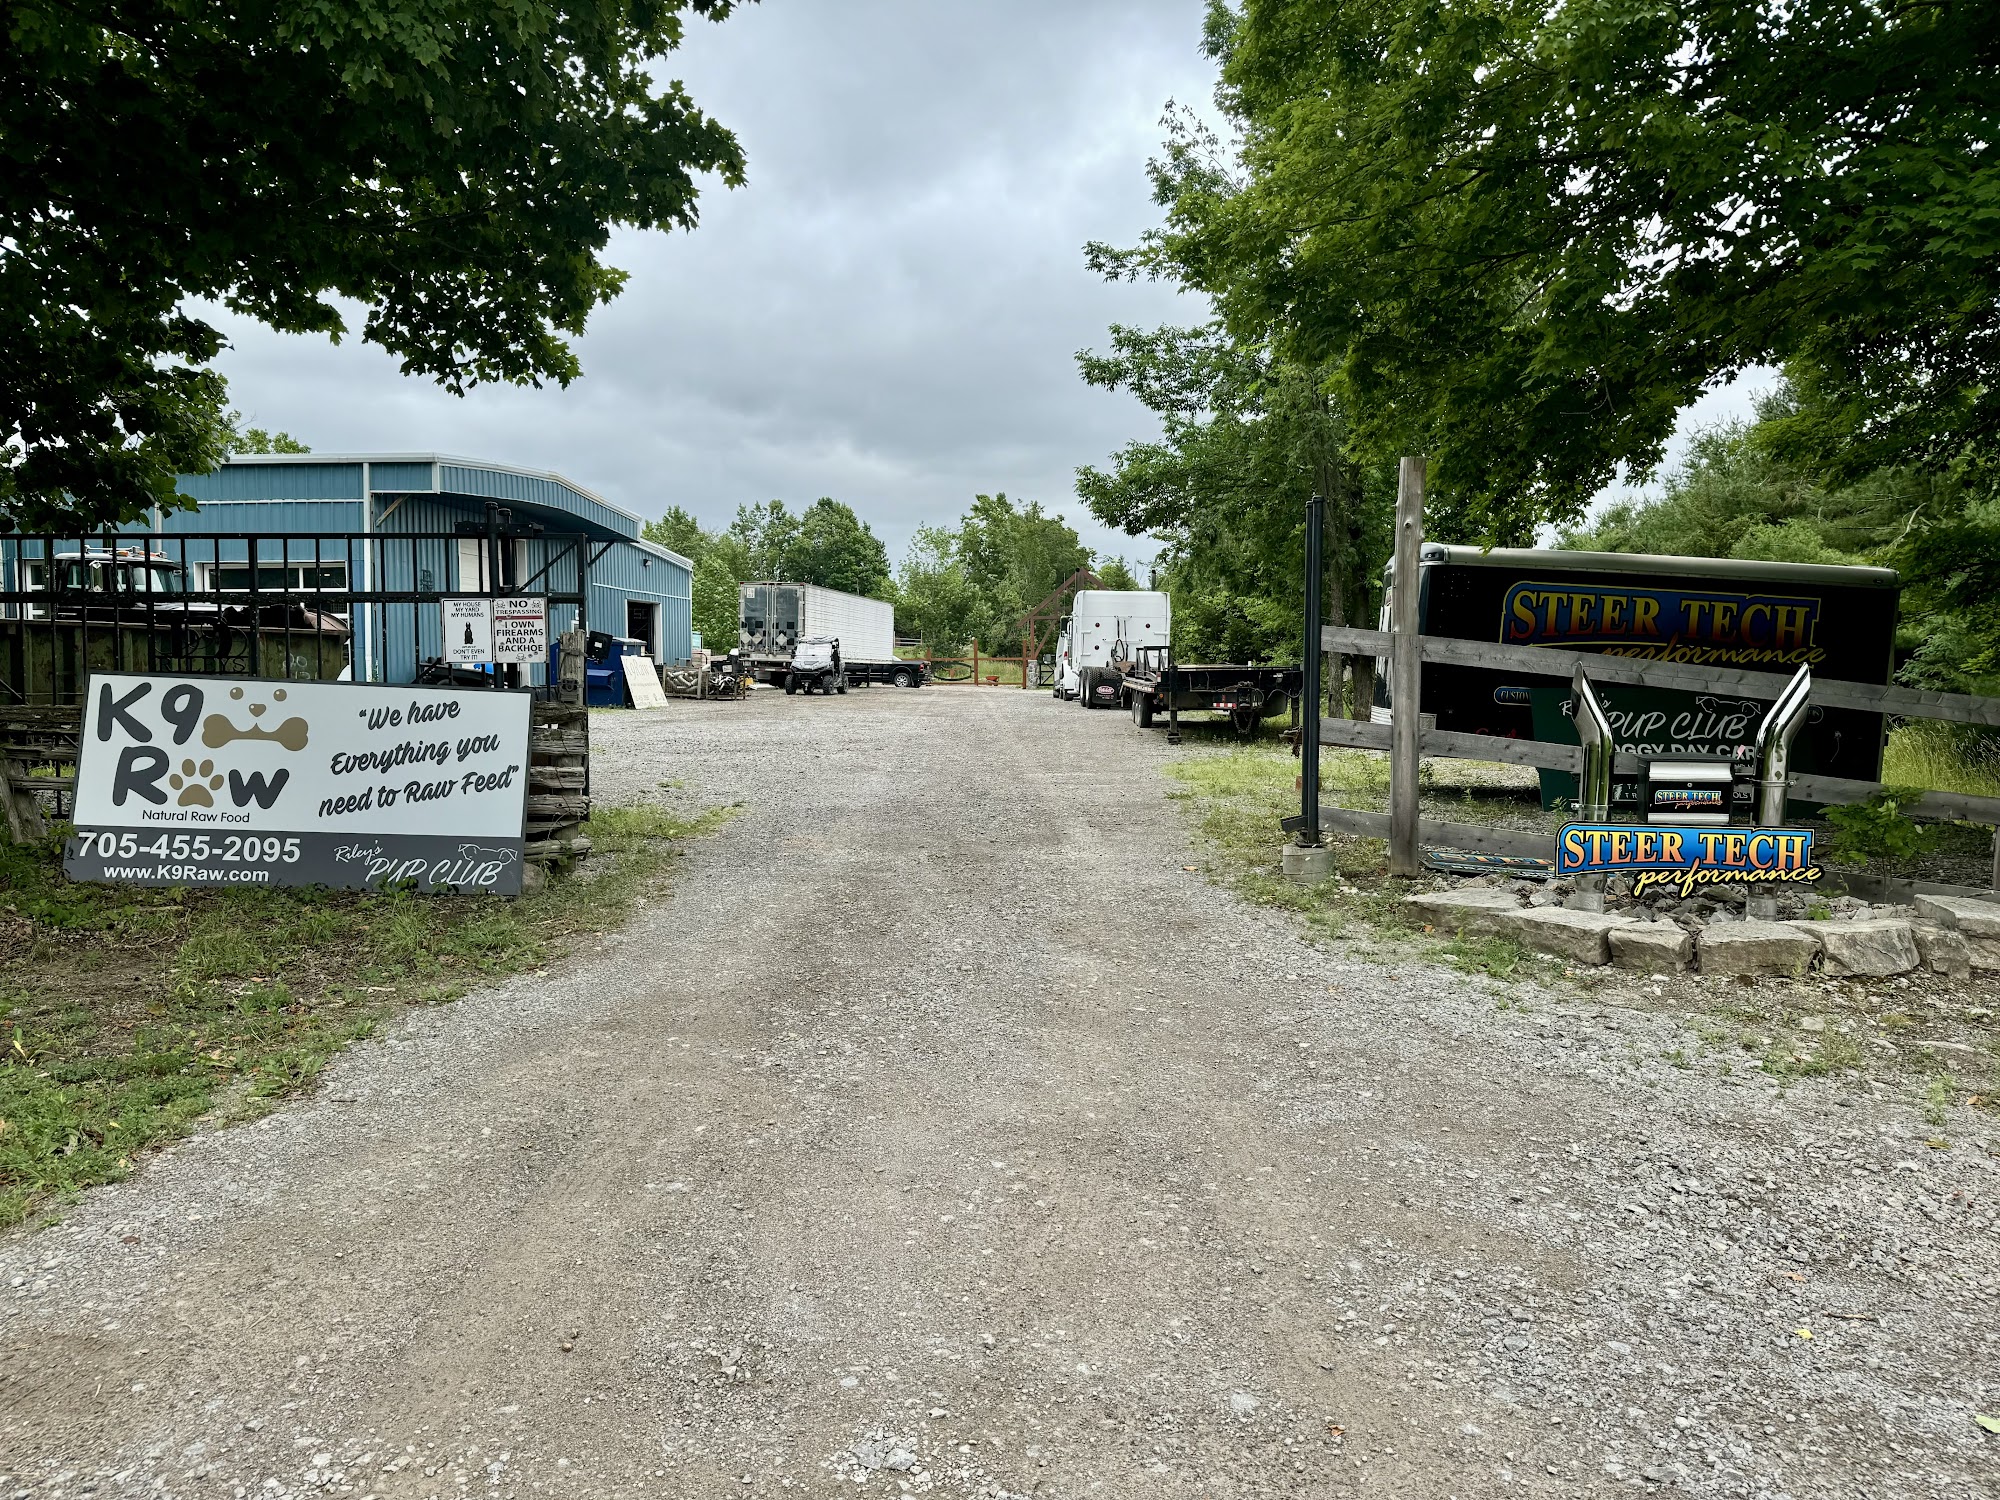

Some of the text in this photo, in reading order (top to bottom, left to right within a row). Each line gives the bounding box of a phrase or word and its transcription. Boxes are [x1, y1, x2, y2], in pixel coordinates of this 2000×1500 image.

[509, 600, 528, 608] NO
[1509, 590, 1811, 650] STEER TECH
[97, 682, 204, 745] K9
[407, 700, 461, 725] have
[1606, 711, 1748, 740] PUP CLUB
[330, 733, 501, 775] Everything you
[318, 787, 372, 817] need
[377, 785, 402, 808] to
[403, 779, 458, 804] Raw
[1657, 791, 1719, 801] STEER TECH
[142, 810, 250, 823] Natural Raw Food
[78, 831, 300, 863] 705-455-2095
[334, 839, 383, 866] Riley's
[1564, 830, 1806, 870] STEER TECH
[103, 864, 269, 881] www.K9Raw.com
[364, 857, 504, 886] PUP CLUB
[1633, 858, 1821, 897] performance
